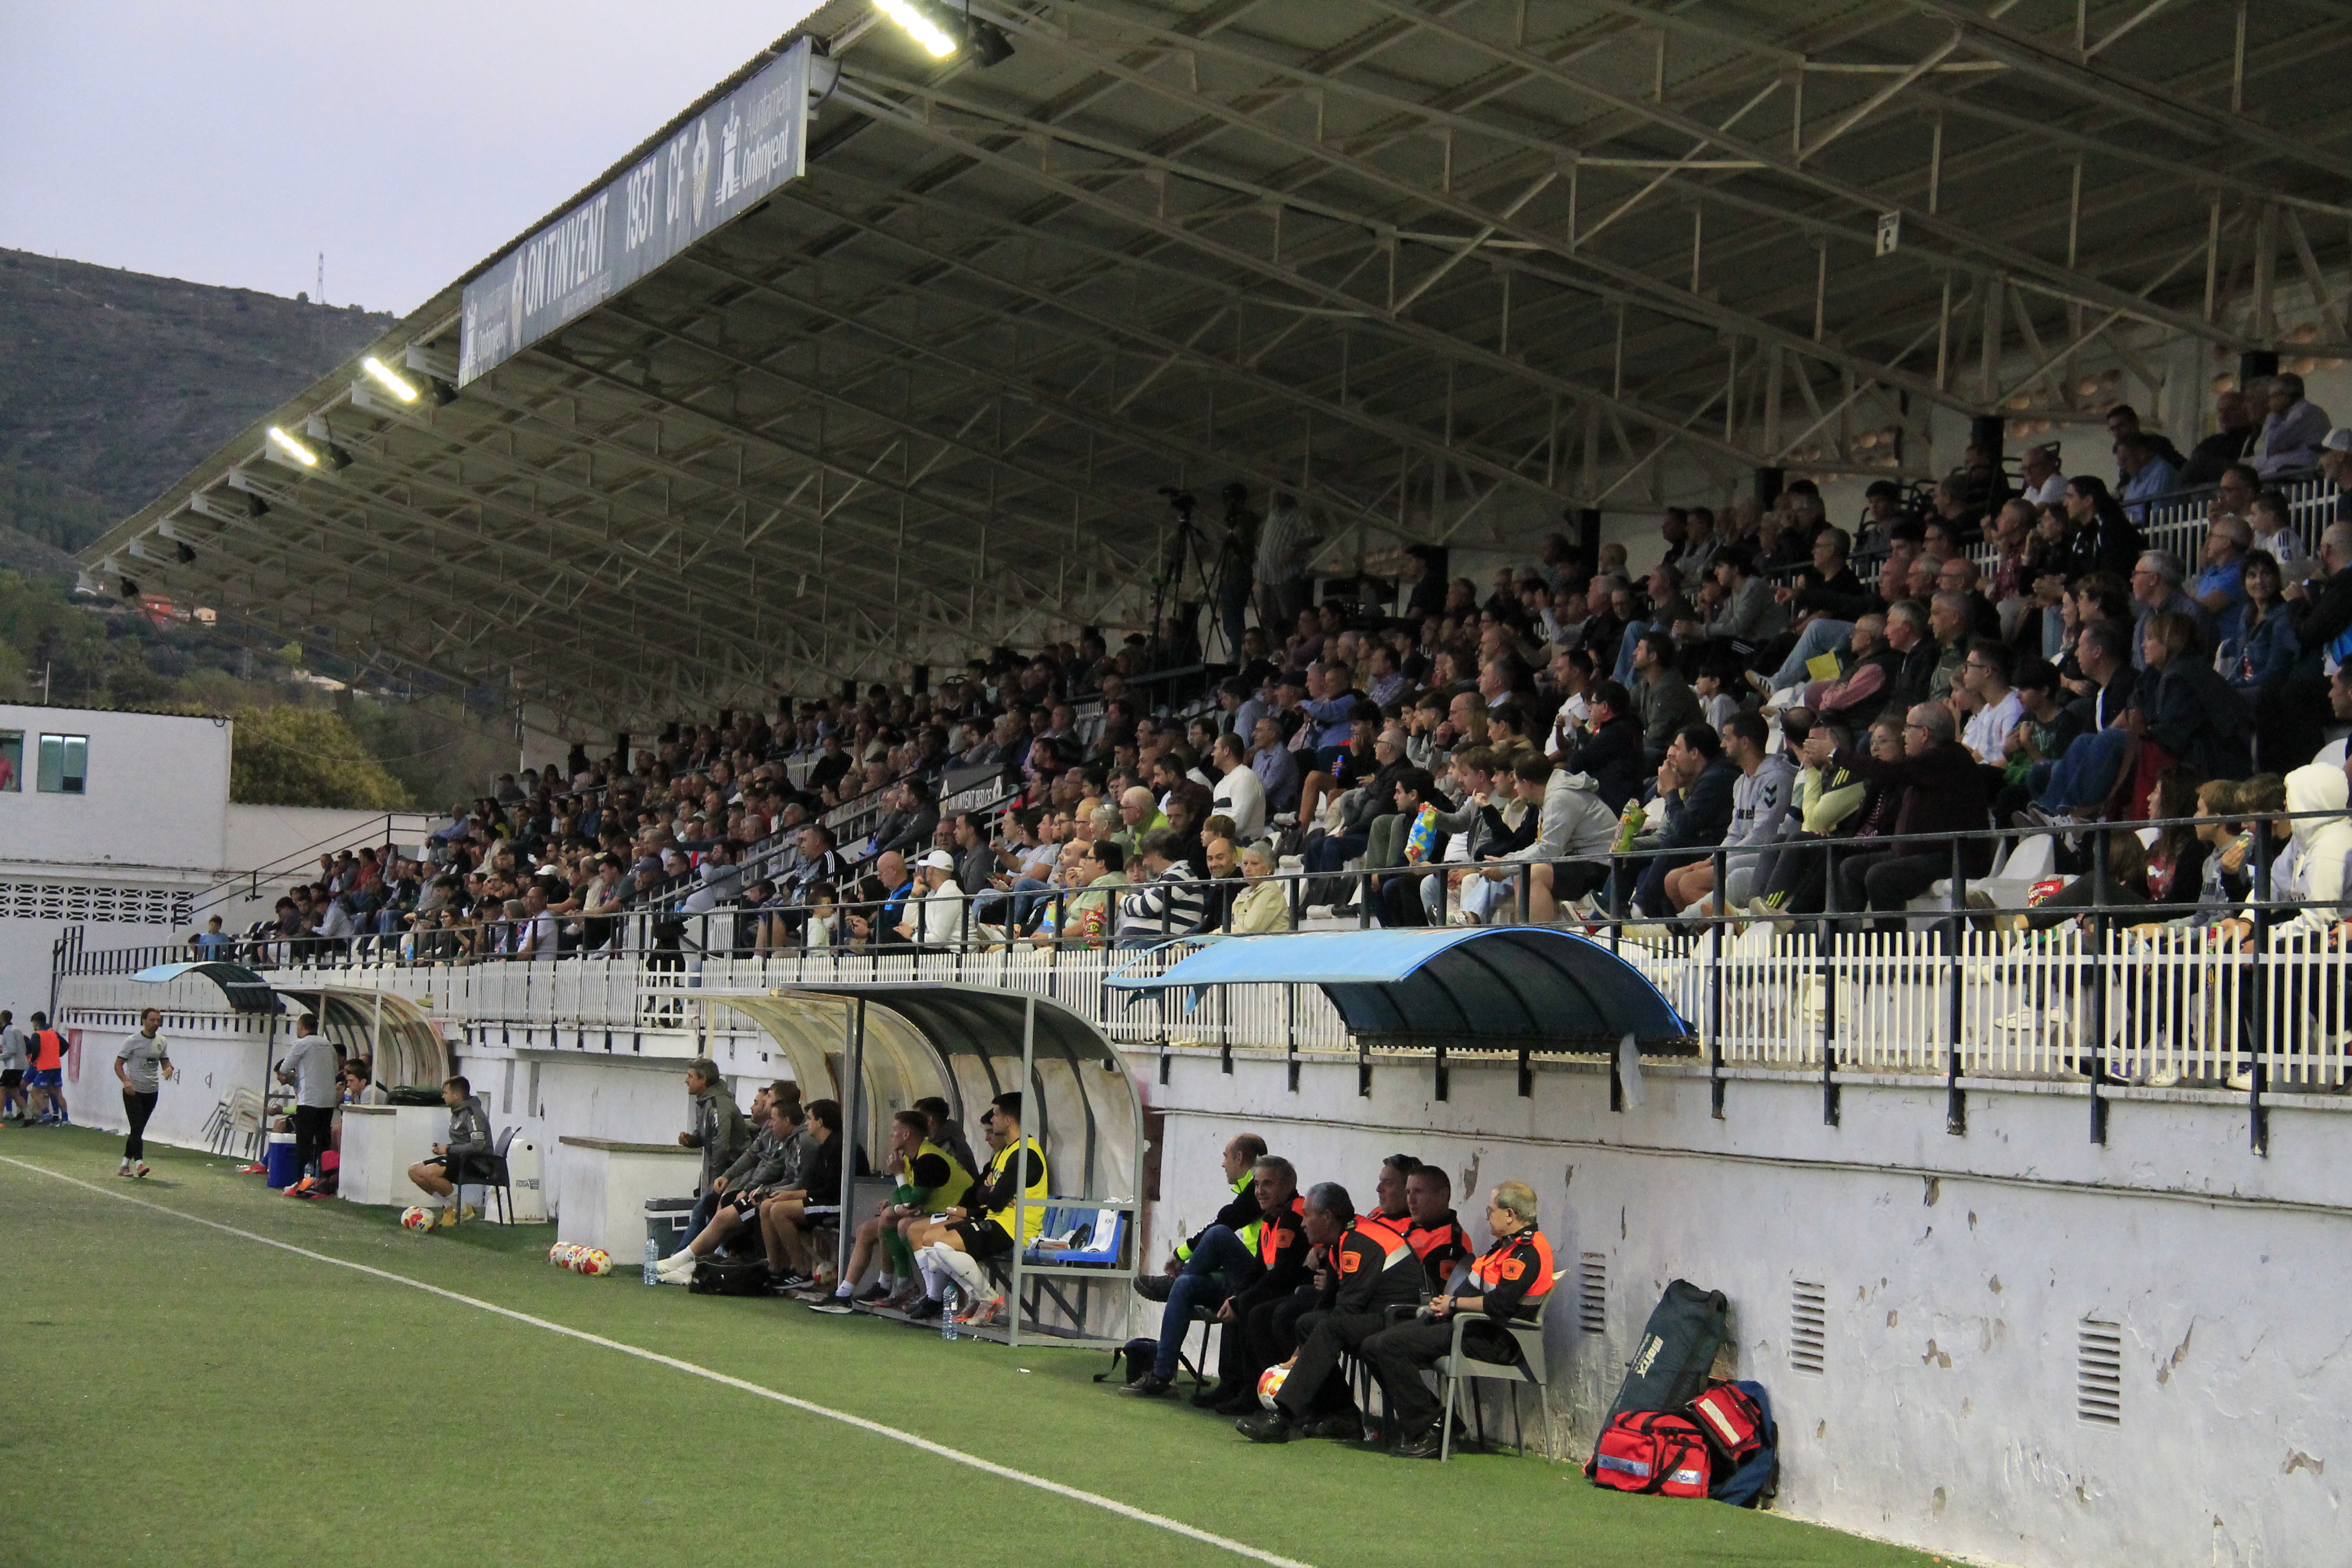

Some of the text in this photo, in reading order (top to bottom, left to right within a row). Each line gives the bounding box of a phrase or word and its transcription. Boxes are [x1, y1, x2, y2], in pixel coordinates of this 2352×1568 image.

[745, 72, 792, 147] Ajuntament
[742, 120, 789, 189] Ontinyent
[526, 193, 608, 316] ONTINYENT
[626, 157, 656, 253] 1931
[666, 133, 688, 226] CF
